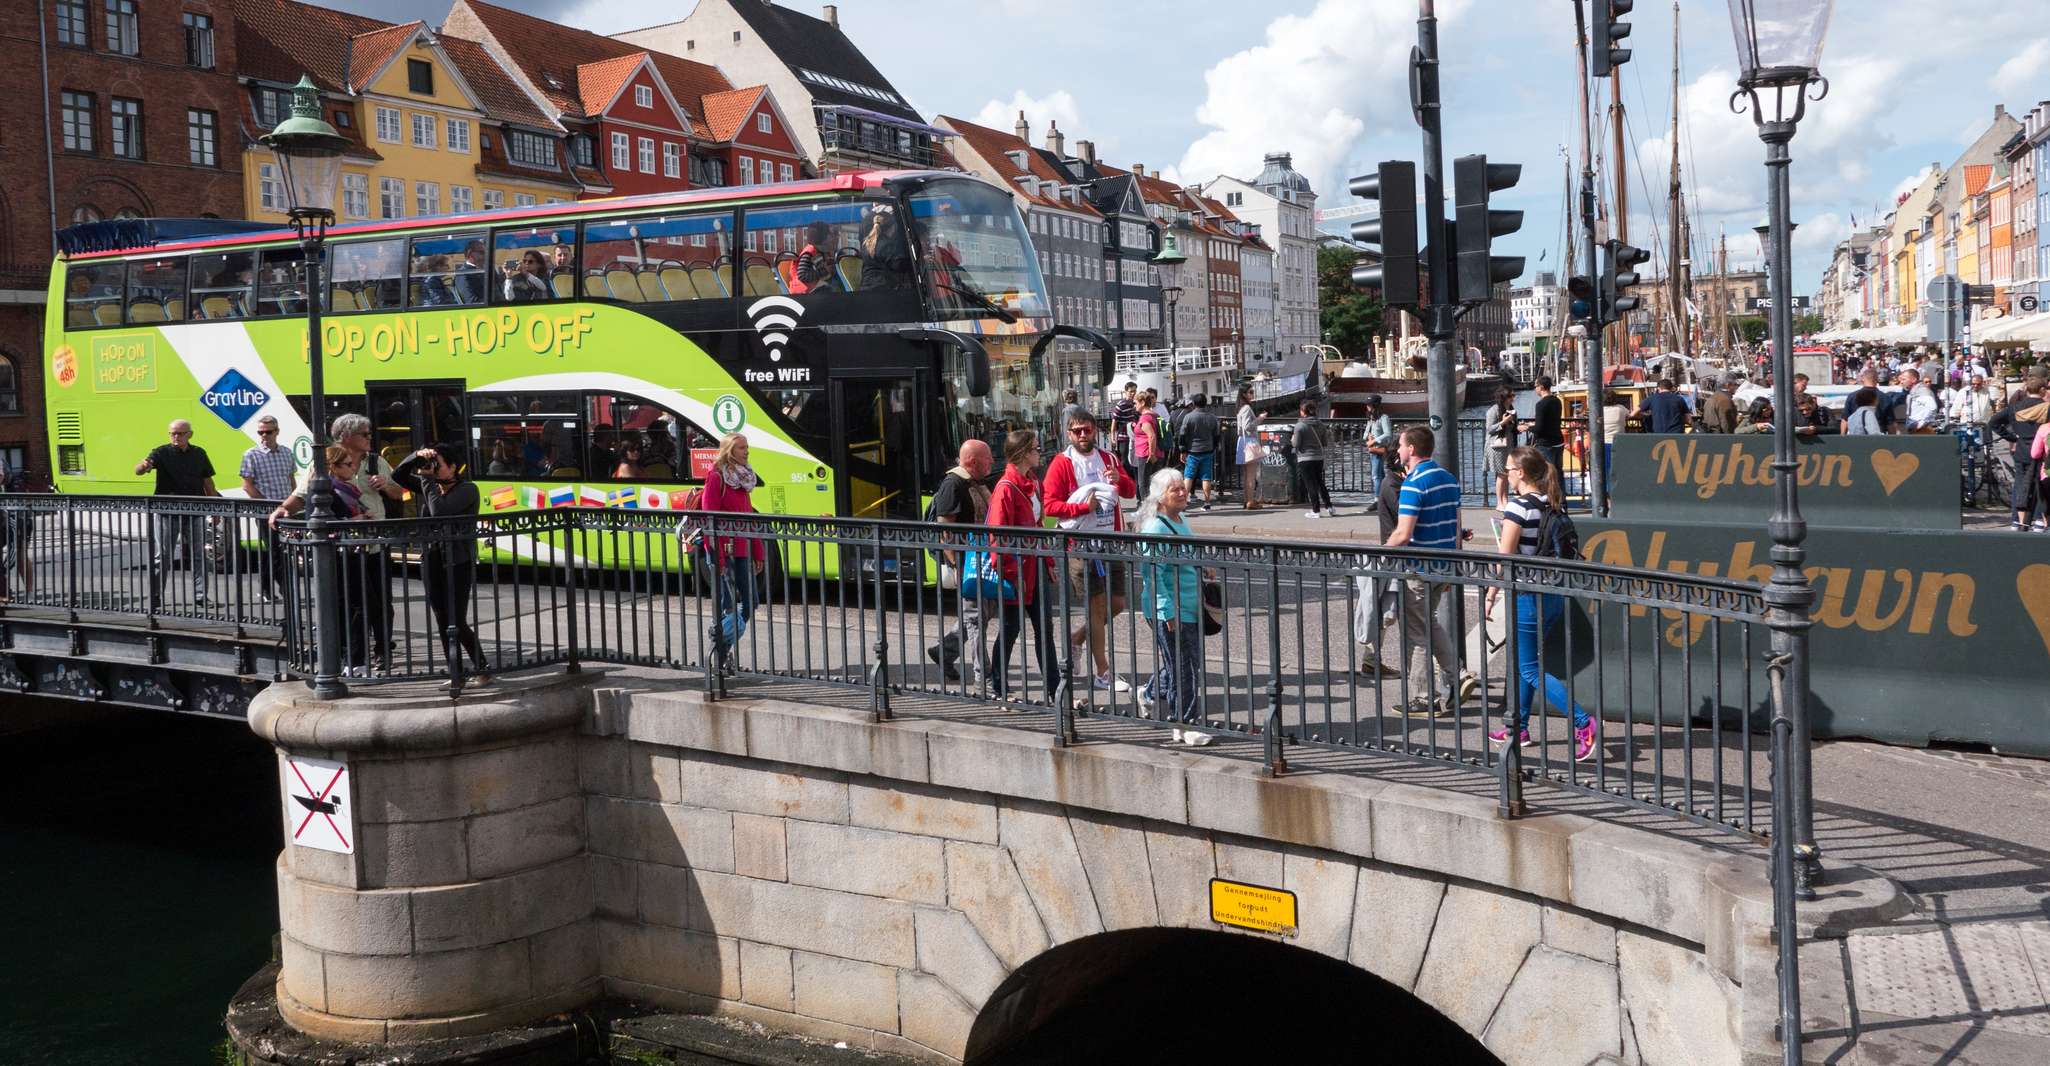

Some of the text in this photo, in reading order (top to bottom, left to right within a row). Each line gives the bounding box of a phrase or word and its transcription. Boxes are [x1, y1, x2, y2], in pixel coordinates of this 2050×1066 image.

[1757, 298, 1799, 308] PISR
[370, 315, 419, 362] ON
[445, 307, 519, 356] HOP
[526, 308, 594, 357] OFF
[101, 343, 145, 362] HOP ON
[60, 366, 75, 383] 48h
[101, 363, 149, 384] HOP OFF
[745, 367, 810, 382] free WiFi
[1224, 886, 1282, 903] Gennemsejling
[1215, 910, 1291, 932] Undervandshindri
